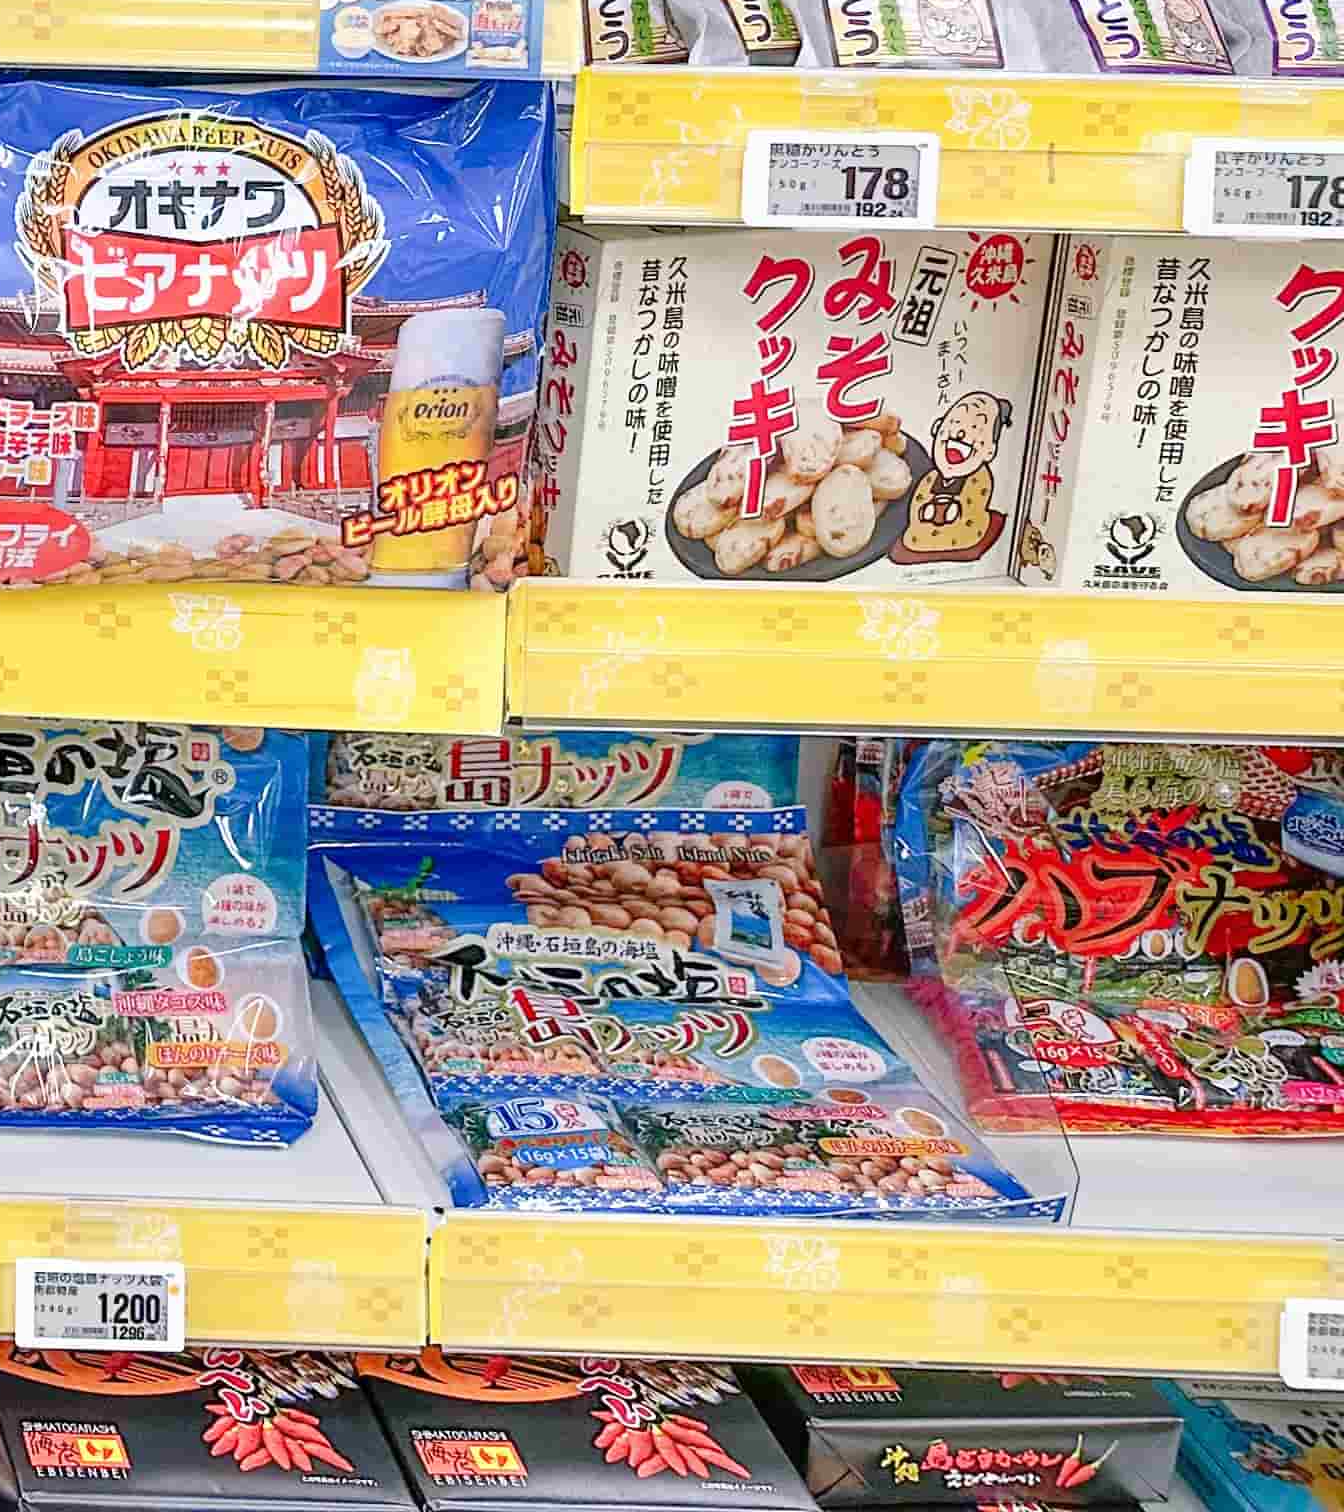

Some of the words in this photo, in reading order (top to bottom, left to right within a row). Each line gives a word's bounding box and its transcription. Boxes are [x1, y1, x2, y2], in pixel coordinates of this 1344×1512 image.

[87, 125, 188, 169] OKINAWA
[190, 125, 247, 148] BEER
[841, 166, 910, 200] 178
[1287, 174, 1344, 209] 178
[108, 178, 285, 233] オキナワ
[900, 255, 951, 338] 元祖
[821, 235, 896, 422] みそ
[645, 257, 689, 506] 久米島の味噌を使用した
[726, 254, 815, 522] クッキー
[1156, 257, 1212, 504] 久米島の味噌を使用した
[1252, 263, 1344, 528] クッキー
[379, 463, 485, 509] オリオン
[342, 478, 518, 544] ビール酵母入り
[446, 740, 676, 806] 島ナッツ
[675, 844, 728, 863] Island
[729, 845, 771, 863] Nuts
[496, 932, 658, 960] 沖縄・石垣島の海塩
[490, 1098, 555, 1132] 15
[812, 1391, 902, 1404] EBISENBEI
[21, 1421, 117, 1434] SHIMATOGARASHI
[411, 1430, 509, 1442] SHIMATOGARASHI
[33, 1466, 130, 1479] EBISENBEI
[432, 1475, 527, 1487] EBISENBEI
